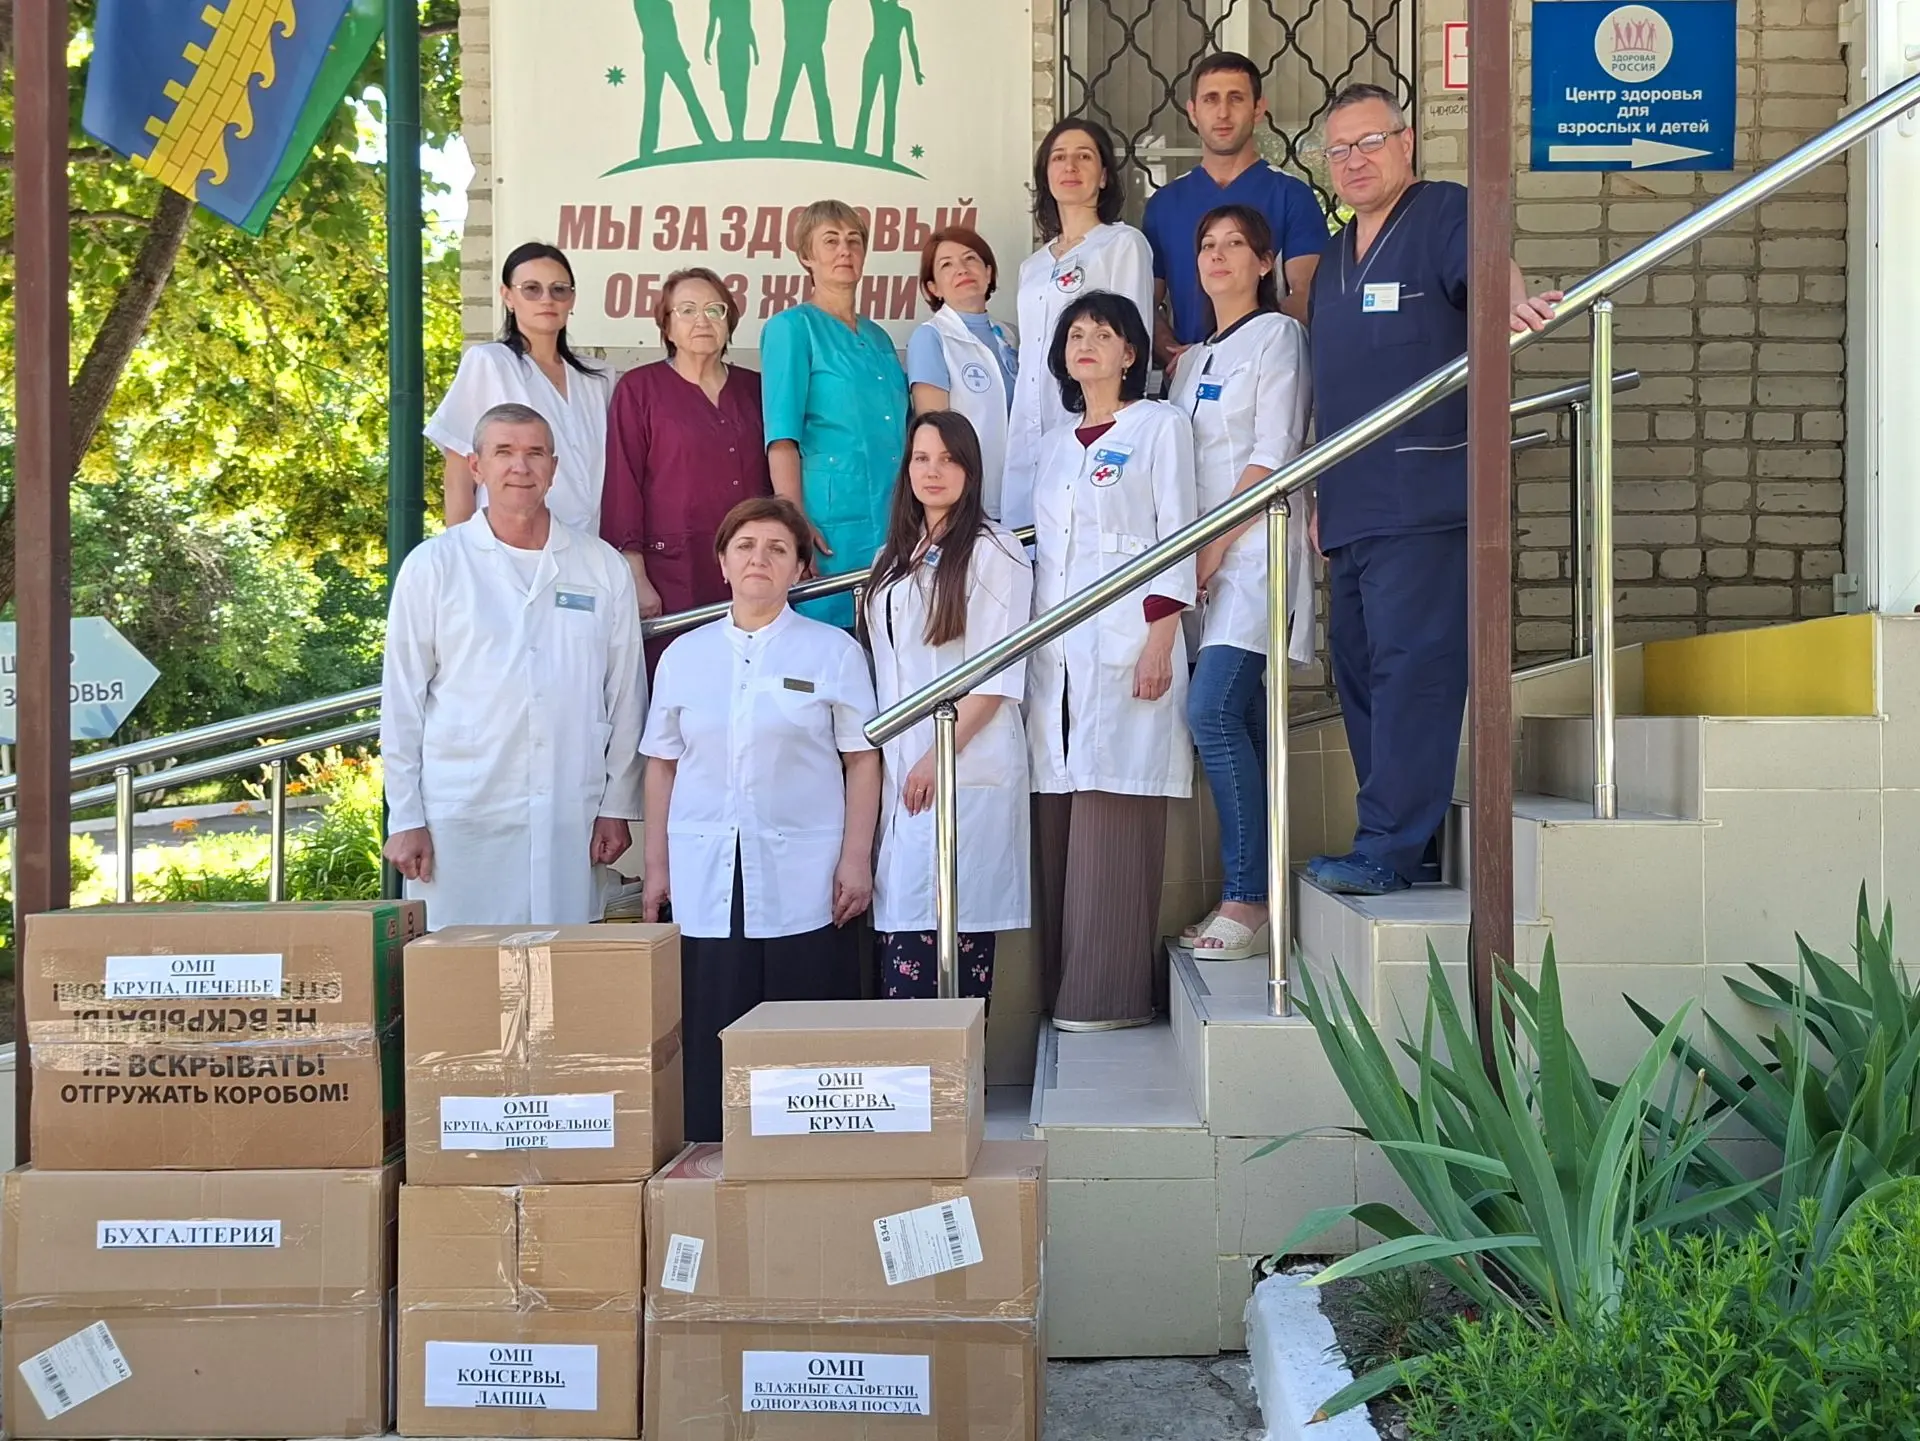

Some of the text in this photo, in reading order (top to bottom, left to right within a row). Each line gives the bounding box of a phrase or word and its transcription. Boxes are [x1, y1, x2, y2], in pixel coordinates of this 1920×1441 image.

[1612, 54, 1656, 62] ЗДОРОВАЯ
[1612, 63, 1656, 72] РОССИЯ
[1565, 87, 1702, 104] Центр здоровья
[1616, 106, 1649, 119] для
[1557, 119, 1710, 136] взрослых и детей
[556, 204, 643, 250] МЫ
[652, 204, 709, 251] ЗА
[604, 272, 748, 319] ОБЗ
[171, 958, 215, 974] ОМП
[112, 980, 180, 996] КРУПА,
[185, 979, 274, 995] ПЕЧЕНЬЕ
[128, 1053, 325, 1078] ВСКРЫВАТЬ!
[817, 1072, 864, 1087] ОМП
[60, 1083, 349, 1105] ОТГРУЖАТЬ КОРОБОМ!
[787, 1092, 895, 1109] КОНСЕРВА,
[503, 1100, 549, 1115] ОМП
[443, 1118, 612, 1133] КРУПА, КАРТОФЕЛЬНОЕ
[809, 1115, 874, 1131] КРУПА
[505, 1134, 549, 1147] ПЮРЕ
[103, 1226, 275, 1245] БУХГАЛТЕРИЯ
[879, 1218, 891, 1242] 8342
[489, 1348, 533, 1363] ОМП
[808, 1358, 865, 1377] ОМП
[457, 1368, 566, 1386] КОНСЕРВЫ,
[475, 1390, 546, 1406] ЛАПША
[754, 1382, 918, 1398] ВЛАЖНЫЕ САЛФЕТКИ,
[750, 1398, 921, 1413] ОДНОРАЗОВАЯ ПОСУДА
